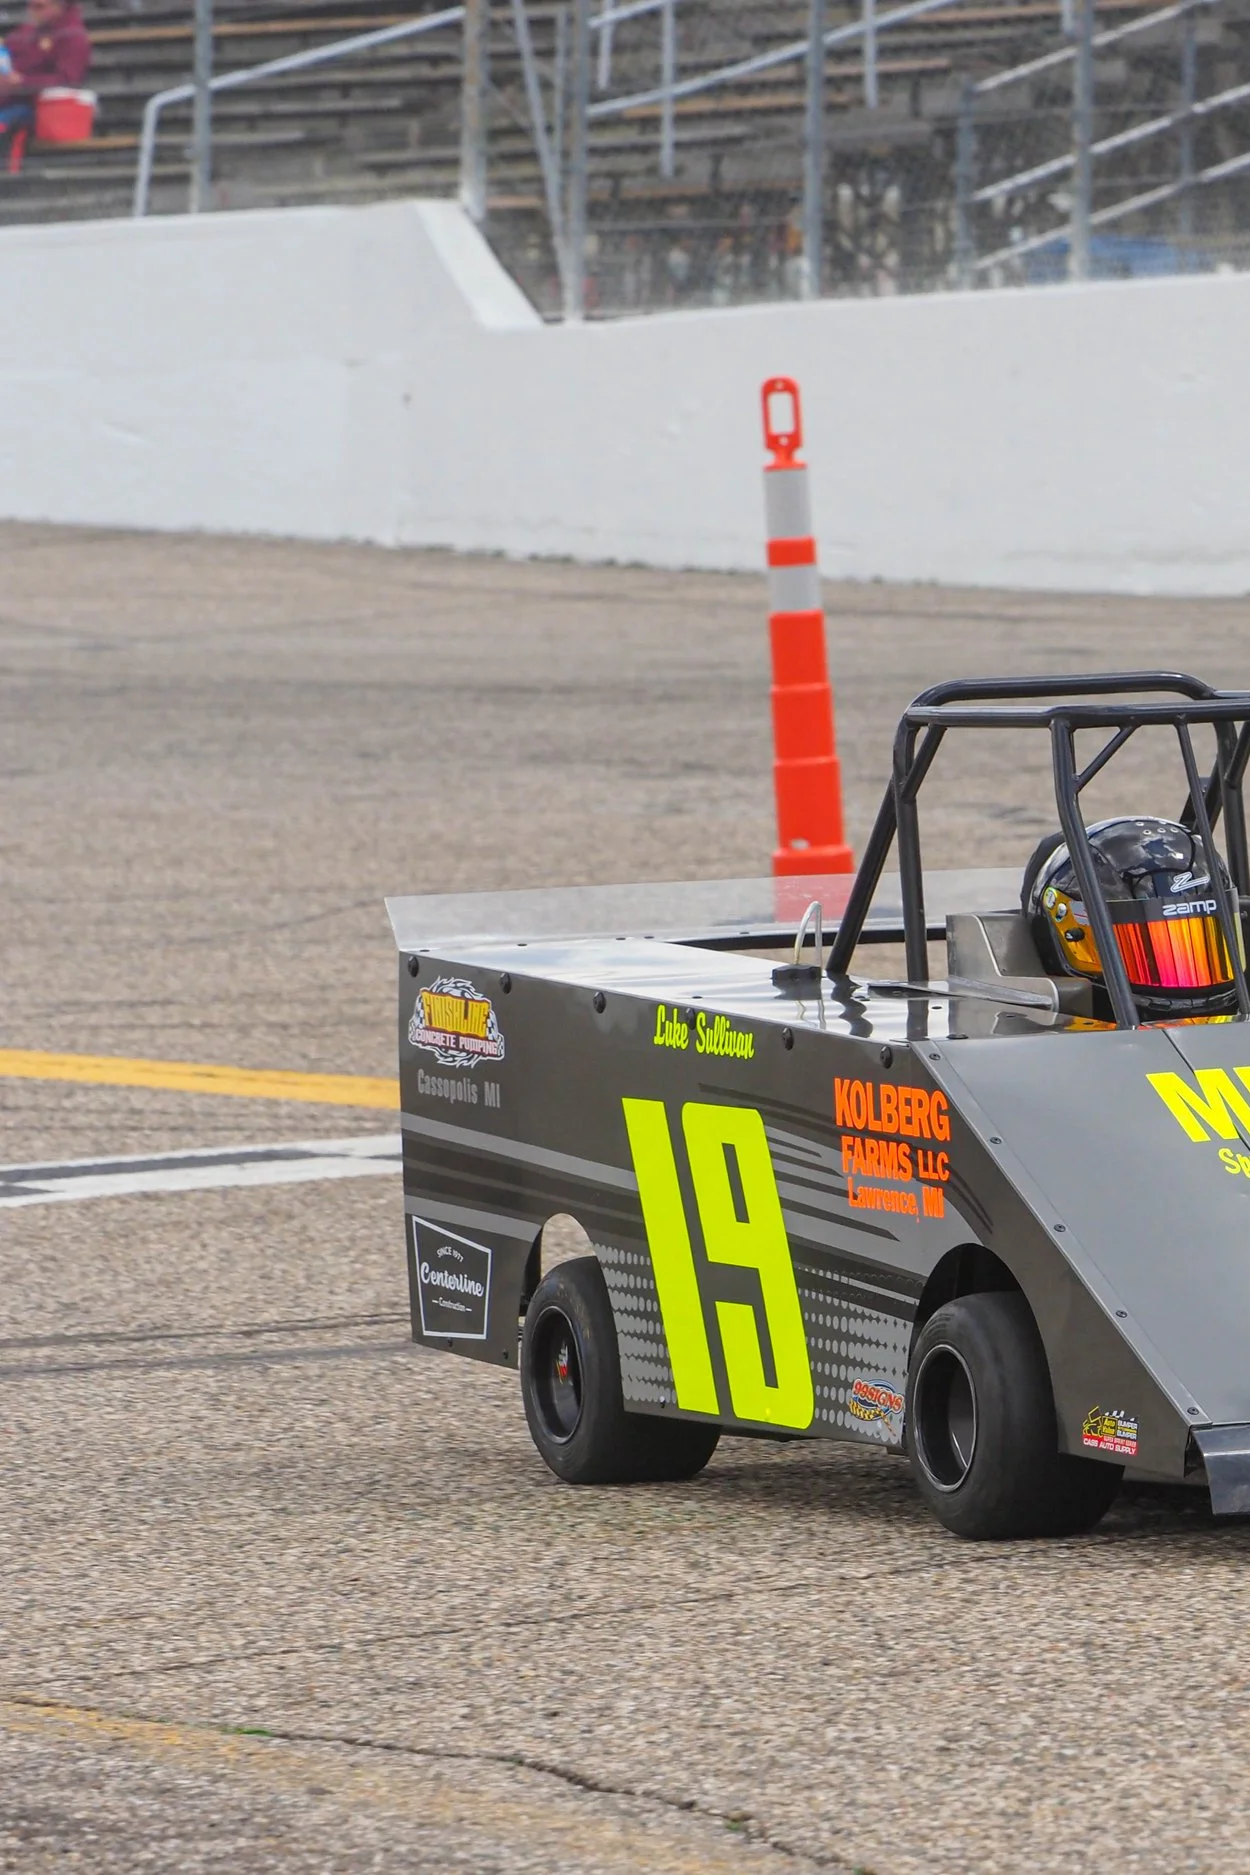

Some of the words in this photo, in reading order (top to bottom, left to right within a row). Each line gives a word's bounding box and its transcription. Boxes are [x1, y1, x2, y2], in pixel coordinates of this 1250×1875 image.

[1162, 899, 1217, 917] zamp
[415, 1027, 457, 1049] CONCRETE
[459, 1035, 498, 1056] PUMPING
[653, 1004, 689, 1050] Luke
[695, 1011, 755, 1060] Sullivan
[417, 1068, 479, 1104] Cassopolis
[484, 1081, 501, 1109] MI
[834, 1077, 951, 1142] KOLBERG
[841, 1135, 913, 1182] FARMS
[917, 1149, 950, 1181] LLC
[847, 1176, 920, 1223] Lawrence,
[922, 1186, 945, 1219] MI
[436, 1245, 452, 1259] SINCE
[621, 1096, 814, 1430] 19
[420, 1262, 484, 1297] Centerline
[1083, 1438, 1098, 1447] CASS
[1099, 1441, 1114, 1450] AUTO
[1115, 1445, 1136, 1455] SUPPLY
